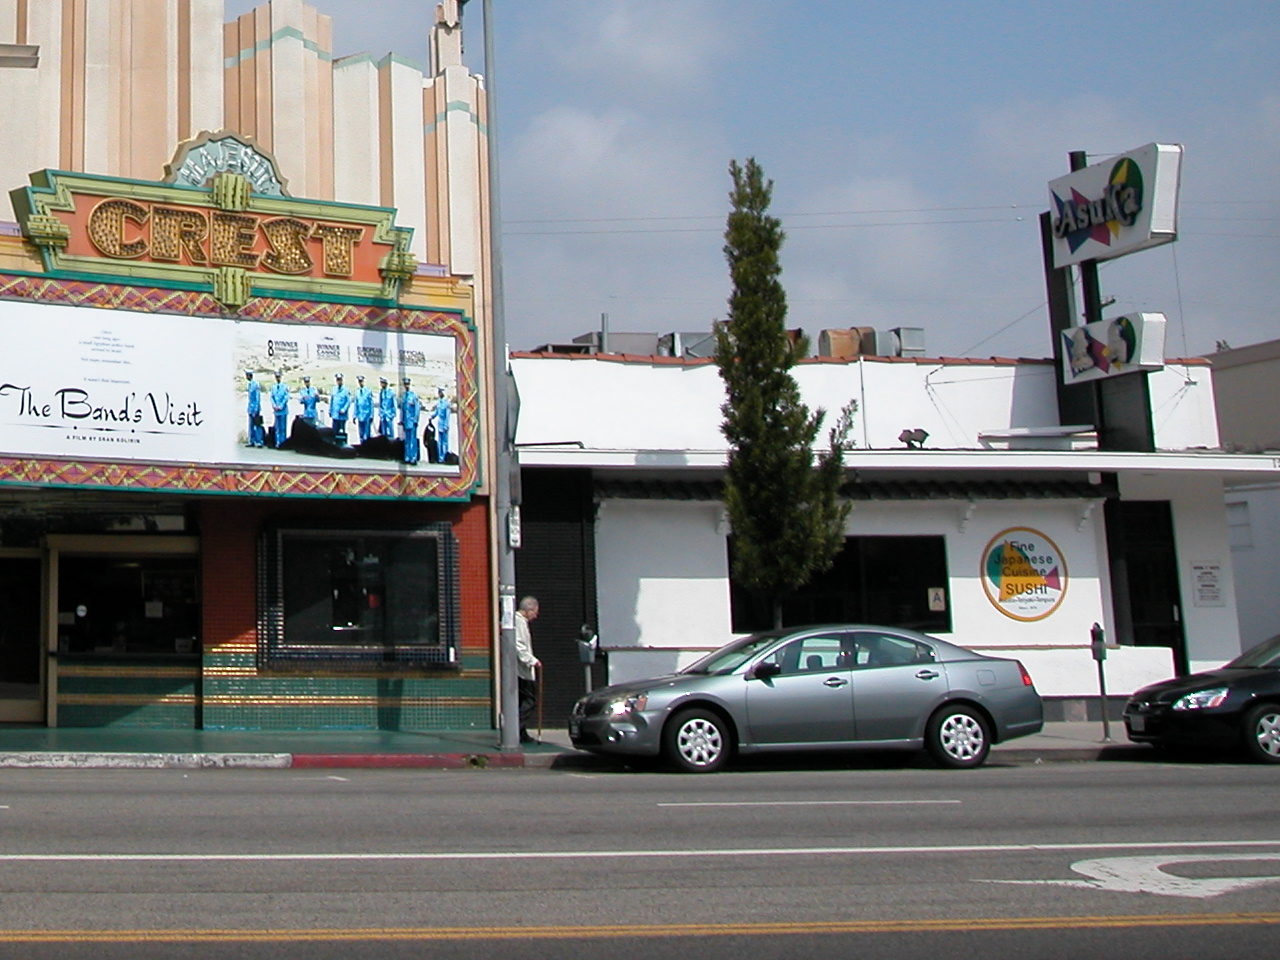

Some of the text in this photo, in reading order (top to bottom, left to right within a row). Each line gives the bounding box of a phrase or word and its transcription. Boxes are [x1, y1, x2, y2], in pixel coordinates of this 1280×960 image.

[87, 197, 366, 277] CREST
[0, 383, 204, 427] The Band's Visit
[1009, 540, 1035, 552] Fine
[994, 555, 1053, 566] Japanese
[1002, 566, 1047, 577] Cuisine
[1005, 582, 1048, 595] SUSHI
[933, 591, 943, 603] A
